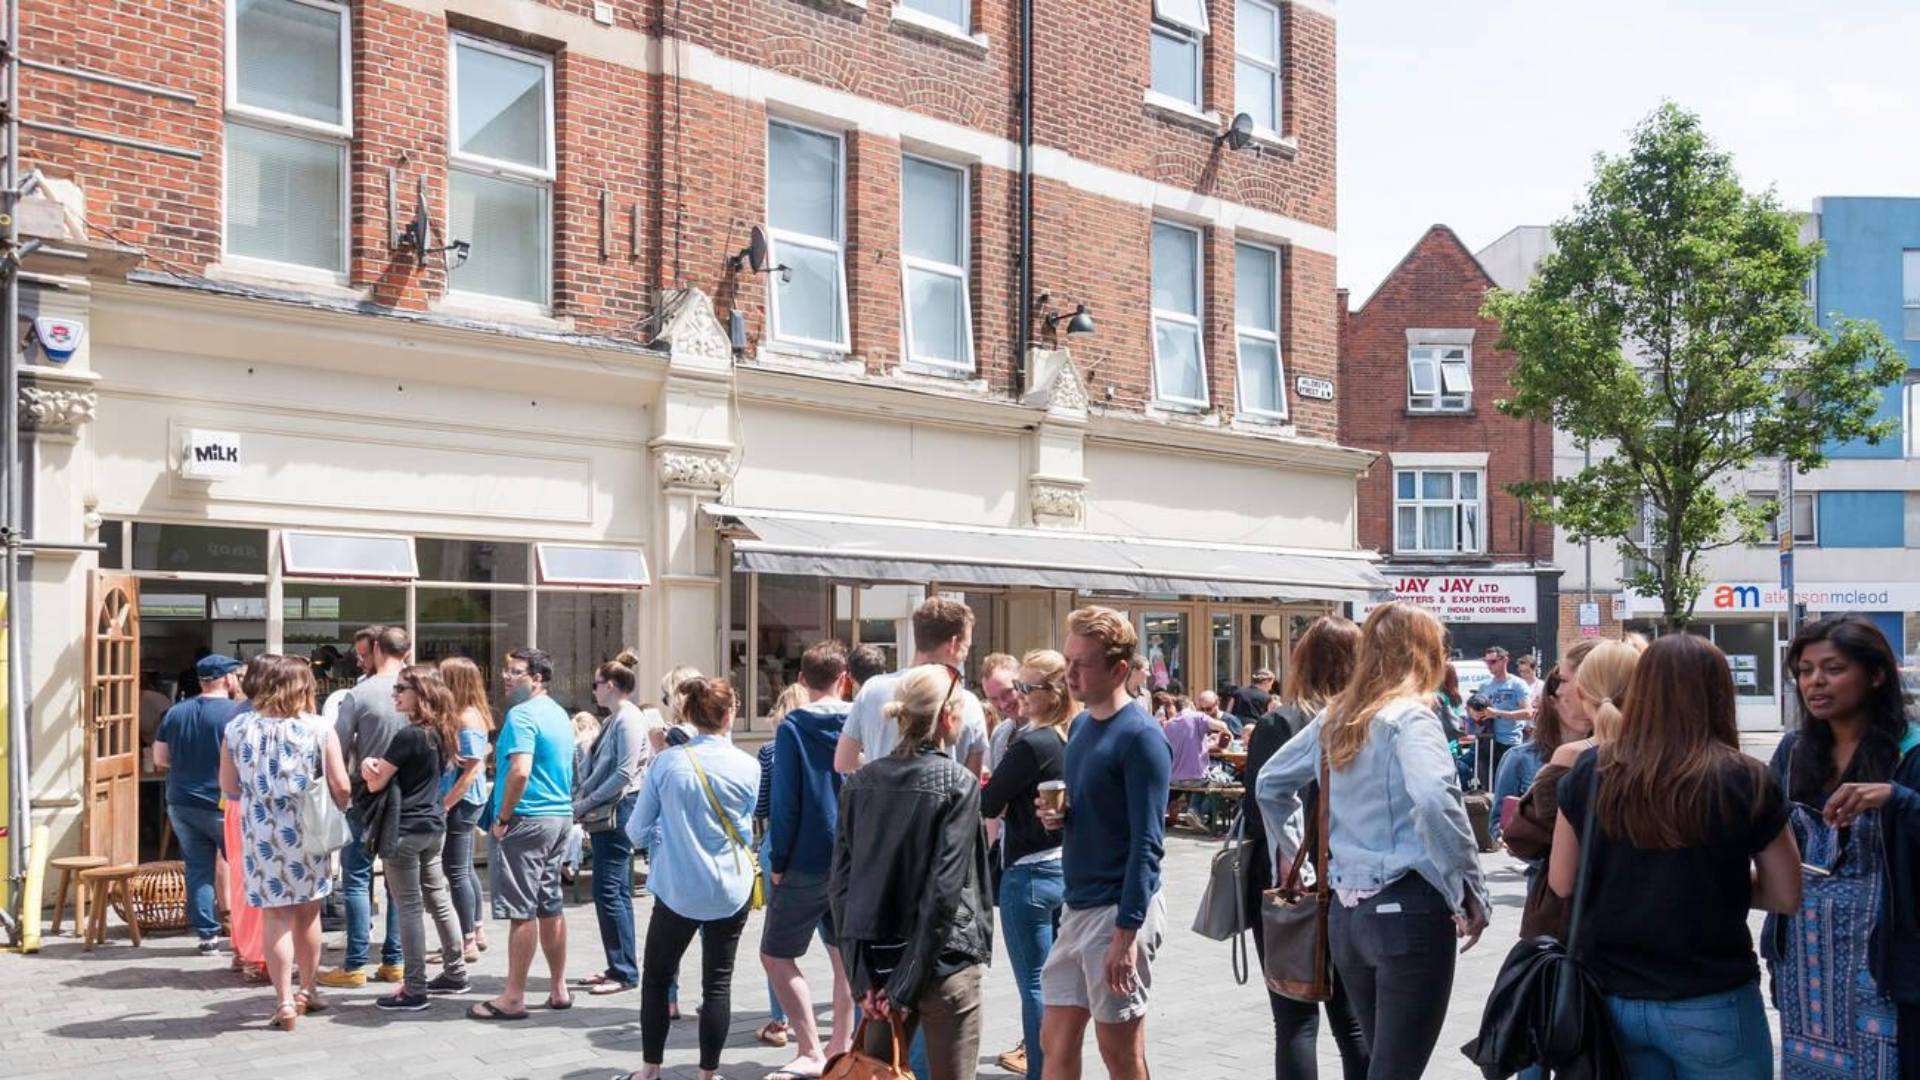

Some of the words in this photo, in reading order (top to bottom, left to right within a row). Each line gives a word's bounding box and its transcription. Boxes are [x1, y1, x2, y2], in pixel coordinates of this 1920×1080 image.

[1395, 578, 1430, 593] JAY
[1439, 578, 1474, 593] JAY
[1478, 583, 1499, 593] LTD
[1439, 595, 1446, 604] &
[1452, 595, 1511, 604] EXPORTERS
[1714, 583, 1760, 608] am
[1447, 606, 1475, 614] INDIAN
[1479, 606, 1526, 614] COSMETICS
